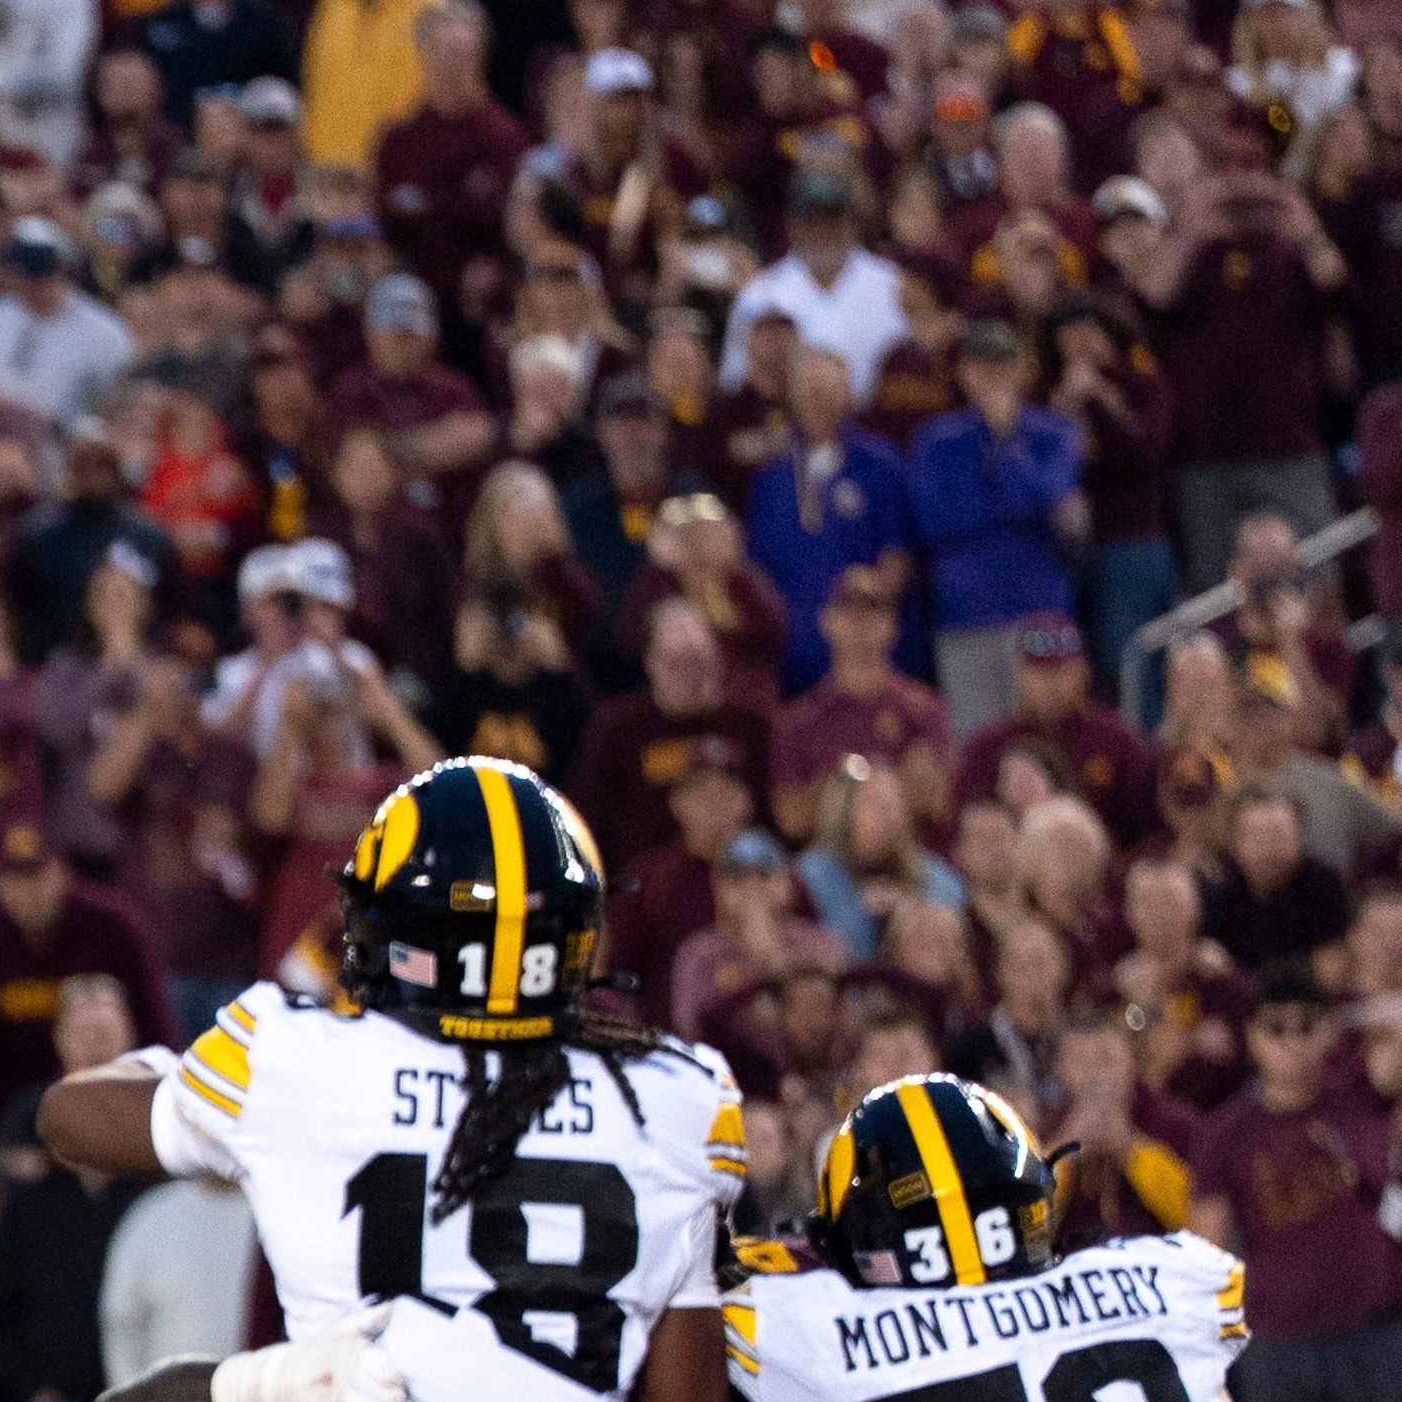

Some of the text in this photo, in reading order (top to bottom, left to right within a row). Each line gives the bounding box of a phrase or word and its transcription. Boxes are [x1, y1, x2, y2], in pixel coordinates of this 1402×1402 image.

[457, 942, 559, 998] 18
[340, 1151, 639, 1397] 18
[902, 1206, 1017, 1285] 36
[834, 1265, 1169, 1374] MONTGOMERY
